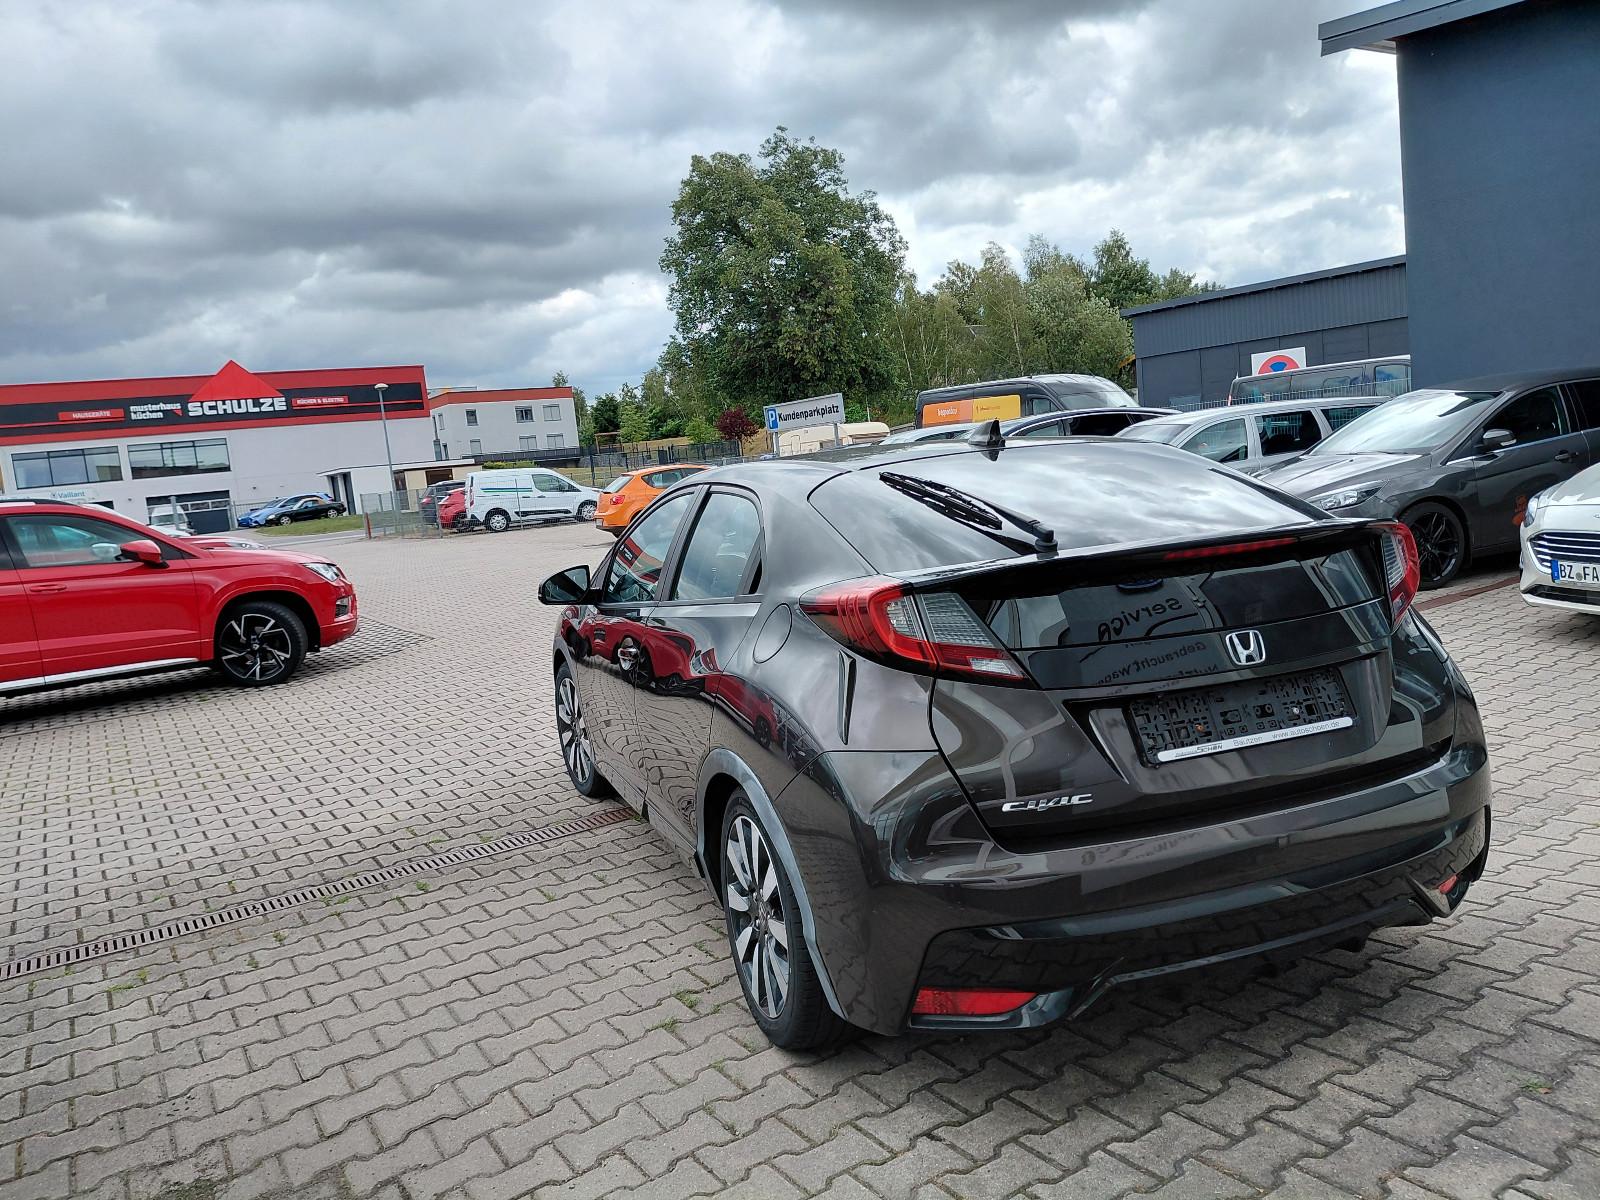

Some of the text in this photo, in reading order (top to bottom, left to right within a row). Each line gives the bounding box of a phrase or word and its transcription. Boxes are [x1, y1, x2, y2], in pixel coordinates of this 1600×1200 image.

[130, 403, 181, 411] musterhaus
[187, 398, 287, 416] SCHULZE
[778, 404, 840, 422] Kundenparkplatz
[58, 491, 86, 499] Vaillant
[1559, 564, 1600, 582] BZ FA
[1001, 793, 1093, 813] CIVIC
